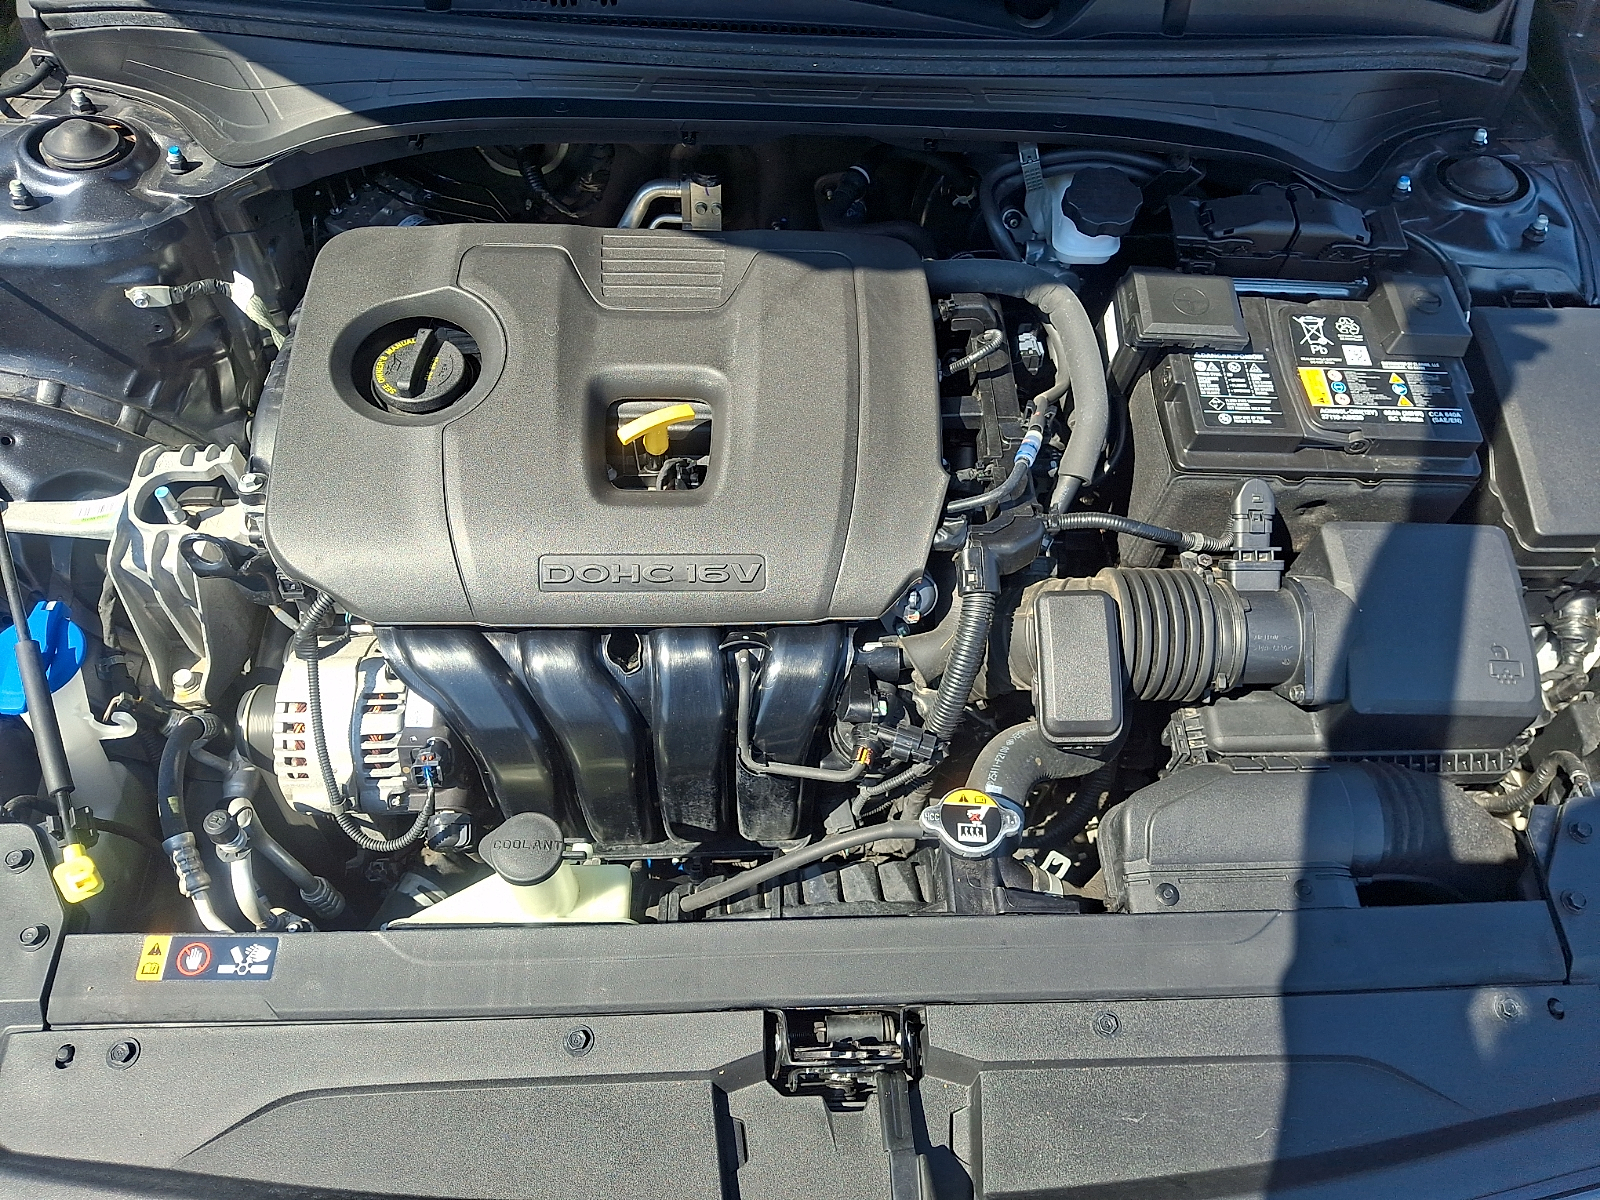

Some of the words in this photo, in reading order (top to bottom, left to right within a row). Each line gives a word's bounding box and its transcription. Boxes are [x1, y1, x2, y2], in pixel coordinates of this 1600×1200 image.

[384, 338, 416, 355] MANUAL
[1310, 344, 1329, 355] Pb
[375, 356, 388, 384] OWNER'S
[381, 383, 396, 394] SEE
[542, 563, 674, 584] DOHC
[686, 563, 763, 584] 16V
[493, 839, 563, 851] COOLANT
